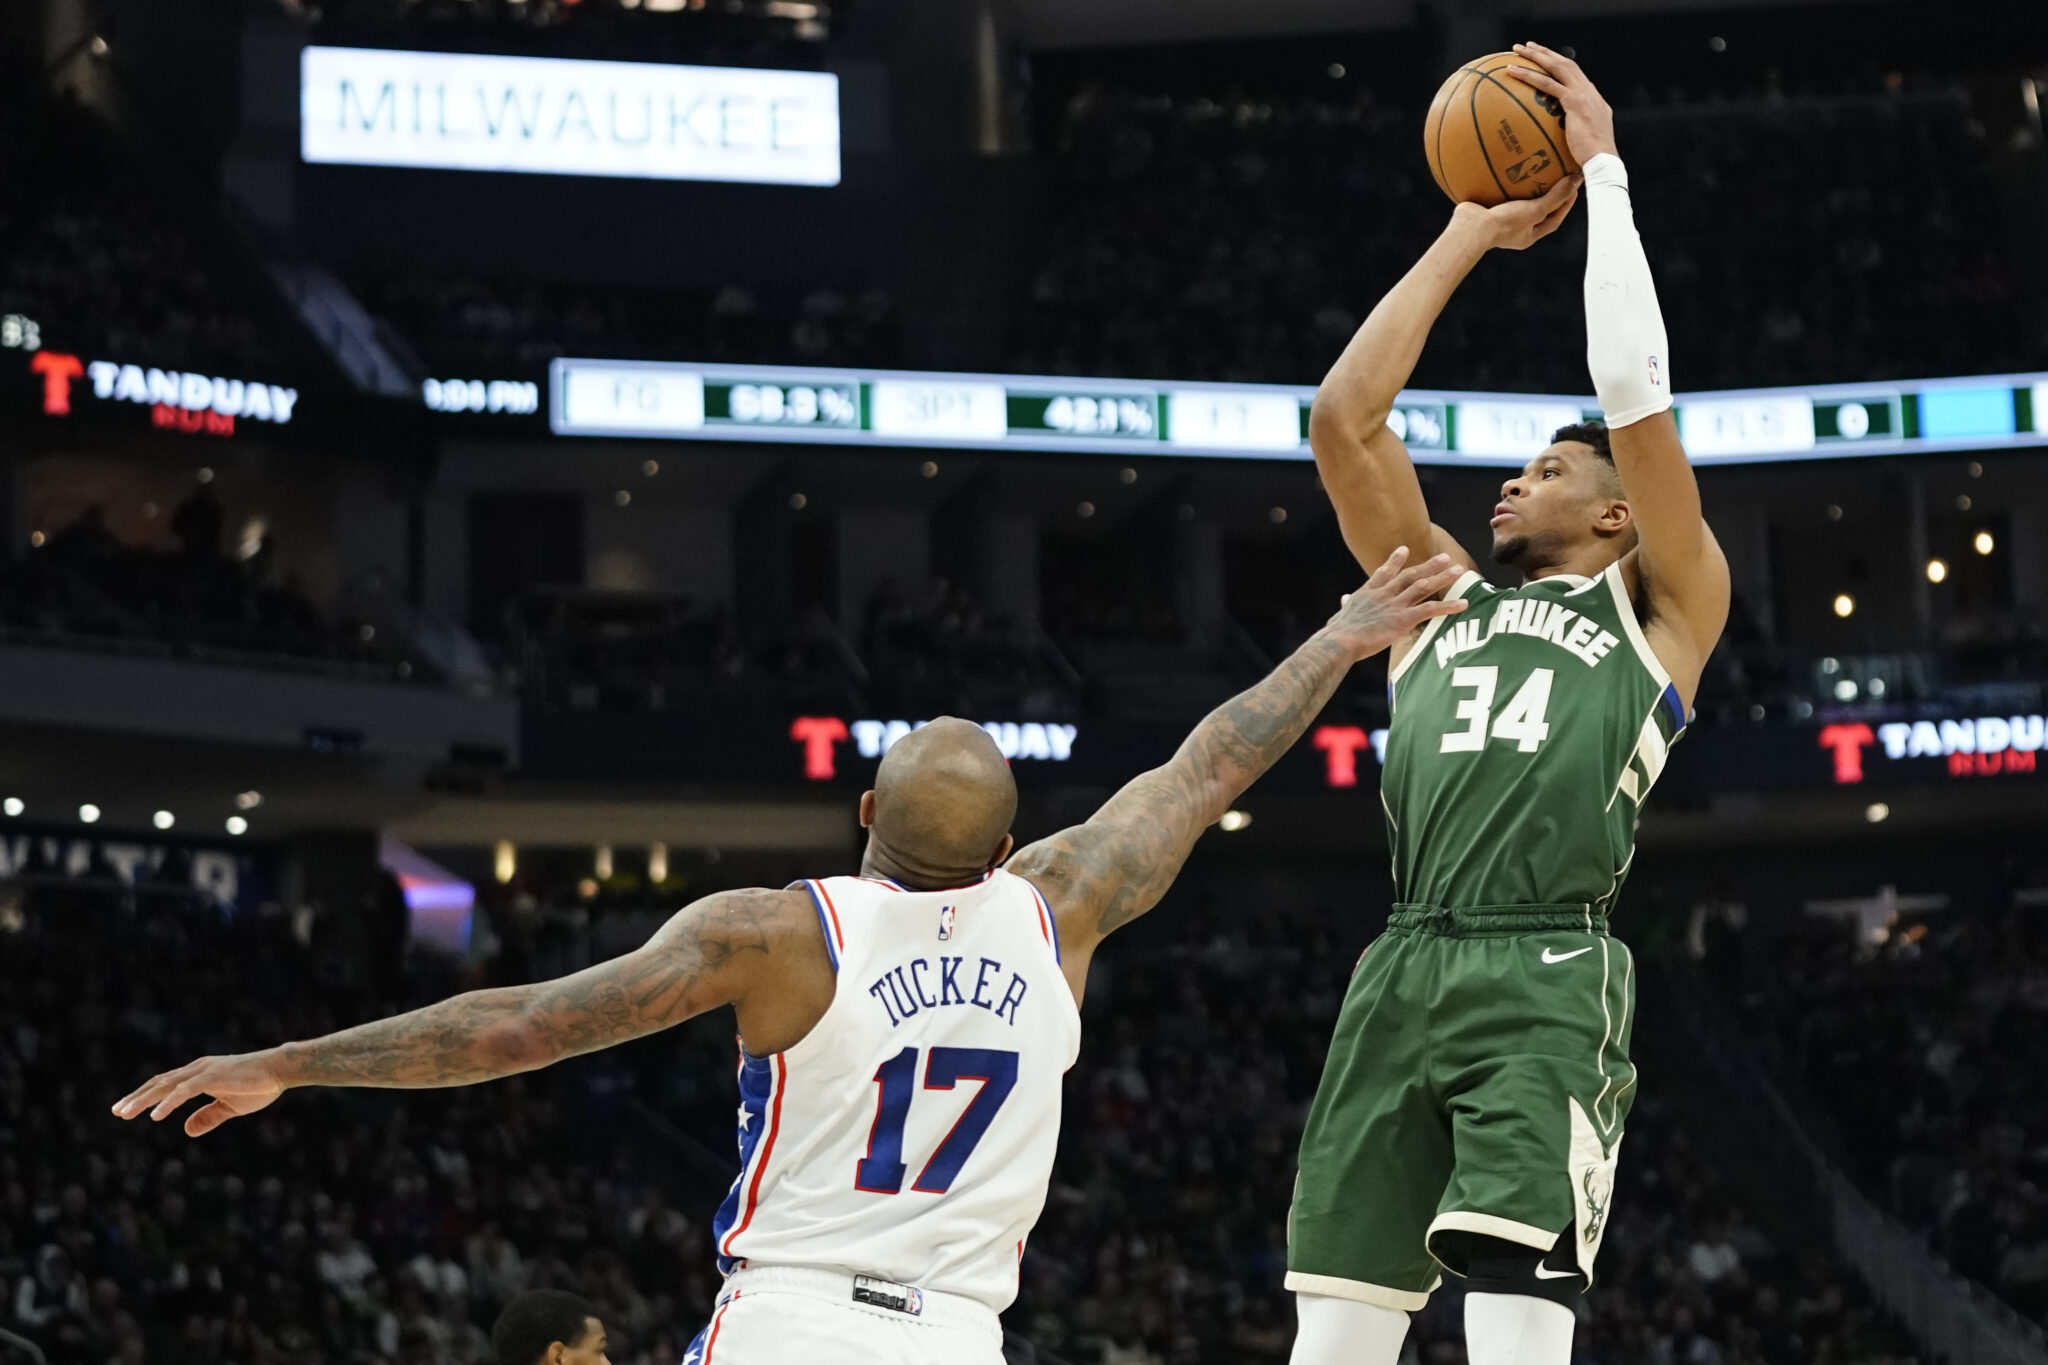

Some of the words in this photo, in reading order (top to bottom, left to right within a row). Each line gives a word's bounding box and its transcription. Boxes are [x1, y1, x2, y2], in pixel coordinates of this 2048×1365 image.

[337, 78, 809, 151] MILWAUKEE
[30, 350, 84, 416] T
[87, 360, 298, 424] TANDUAY
[151, 402, 235, 437] RUM
[1434, 599, 1620, 669] MILAUKEE
[1440, 666, 1554, 754] 34
[790, 716, 848, 780] T
[850, 719, 1078, 761] TAUAY
[1312, 725, 1369, 788] T
[1819, 721, 1875, 784] T
[1877, 714, 2048, 760] TANDU
[1948, 746, 2036, 777] RUM
[868, 956, 1027, 1028] TUCKER
[854, 1046, 1020, 1194] 17
